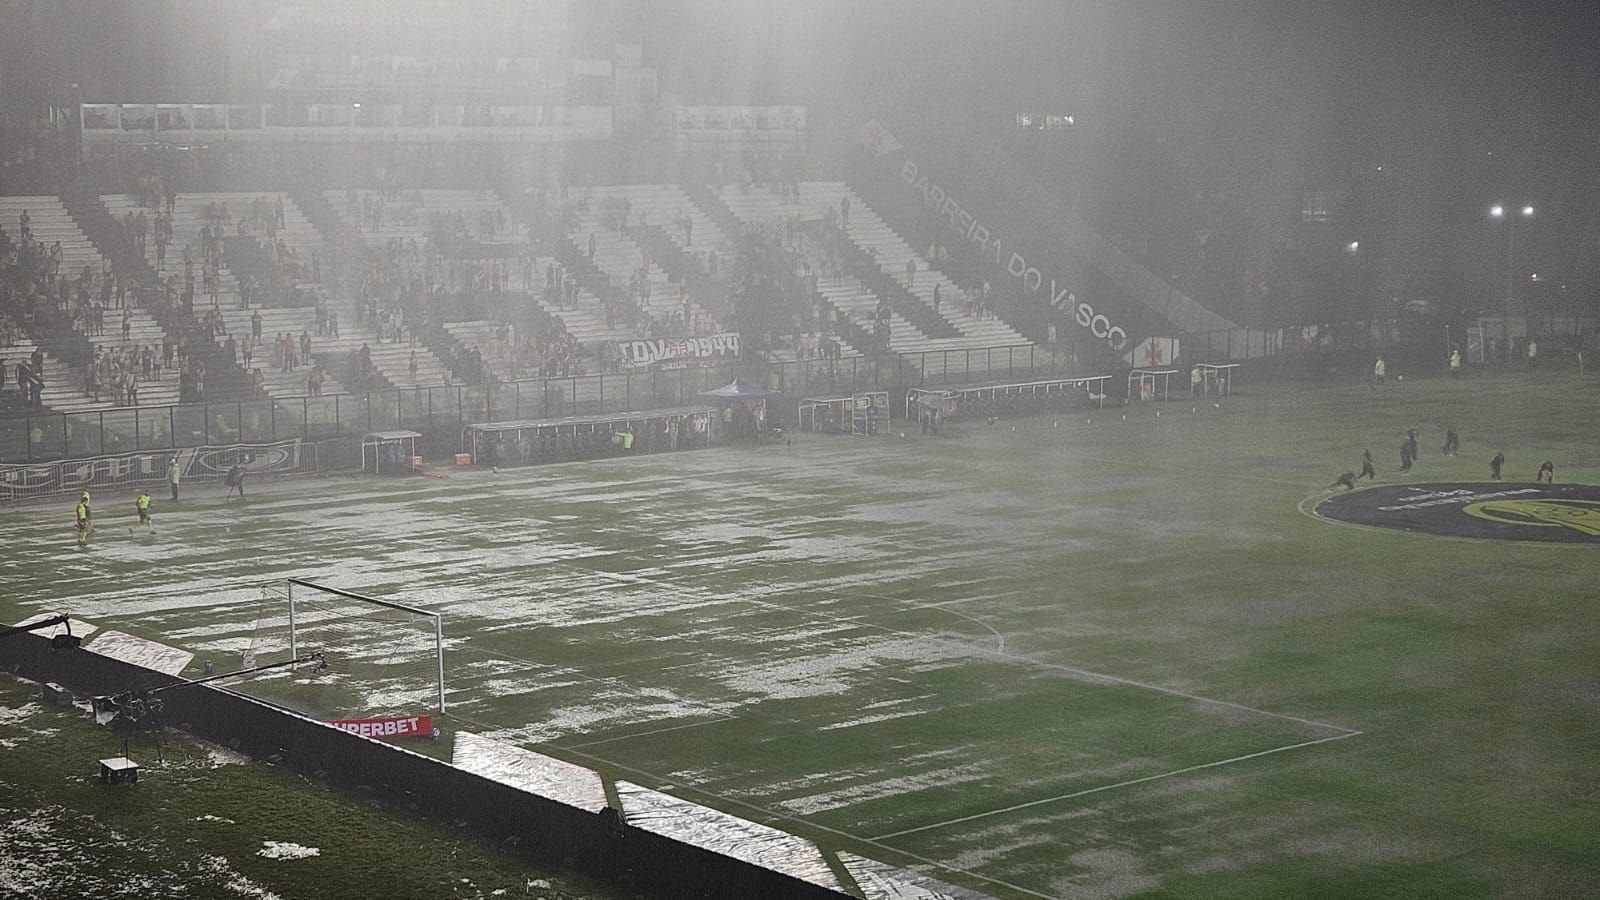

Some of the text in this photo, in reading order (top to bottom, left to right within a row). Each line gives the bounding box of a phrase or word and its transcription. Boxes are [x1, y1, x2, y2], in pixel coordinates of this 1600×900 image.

[901, 160, 1127, 350] BARREIRA DO VASCO
[687, 336, 740, 358] 1944
[329, 717, 419, 737] UPERBET
